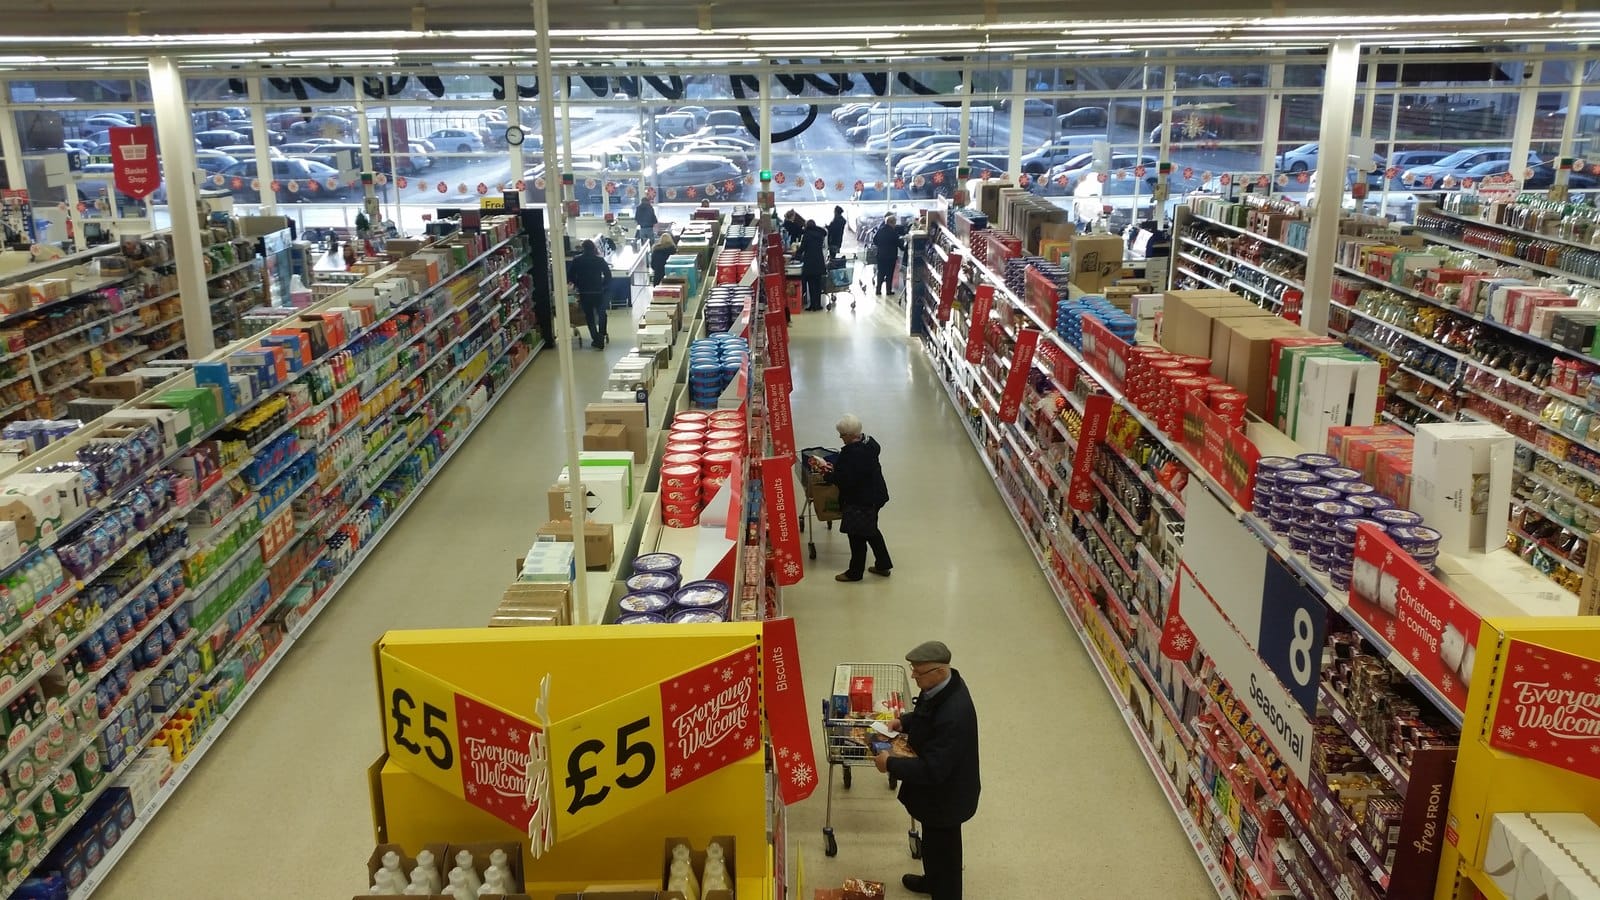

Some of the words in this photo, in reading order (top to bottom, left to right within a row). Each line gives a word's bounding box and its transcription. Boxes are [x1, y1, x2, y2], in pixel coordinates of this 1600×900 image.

[124, 167, 148, 175] Basket
[127, 175, 147, 184] Shop
[1081, 437, 1095, 473] Selection
[1088, 414, 1100, 436] Boxes
[774, 477, 786, 511] Biscuits
[779, 512, 789, 542] Festive
[1398, 605, 1406, 622] is
[1405, 616, 1438, 654] coming
[1399, 586, 1443, 631] Christmas
[771, 645, 788, 693] Biscuits
[1289, 607, 1314, 687] 8
[672, 676, 751, 740] Everyone's
[1249, 672, 1304, 763] Seasonal
[1512, 681, 1600, 717] Everyo
[1515, 704, 1600, 739] Welcom
[391, 687, 454, 771] £5
[677, 701, 750, 760] Welcome
[465, 736, 532, 776] Everyone
[470, 761, 531, 797] Welcom
[564, 715, 657, 816] £5
[1381, 764, 1390, 777] £2
[1413, 822, 1437, 854] free
[1426, 783, 1443, 819] FROM
